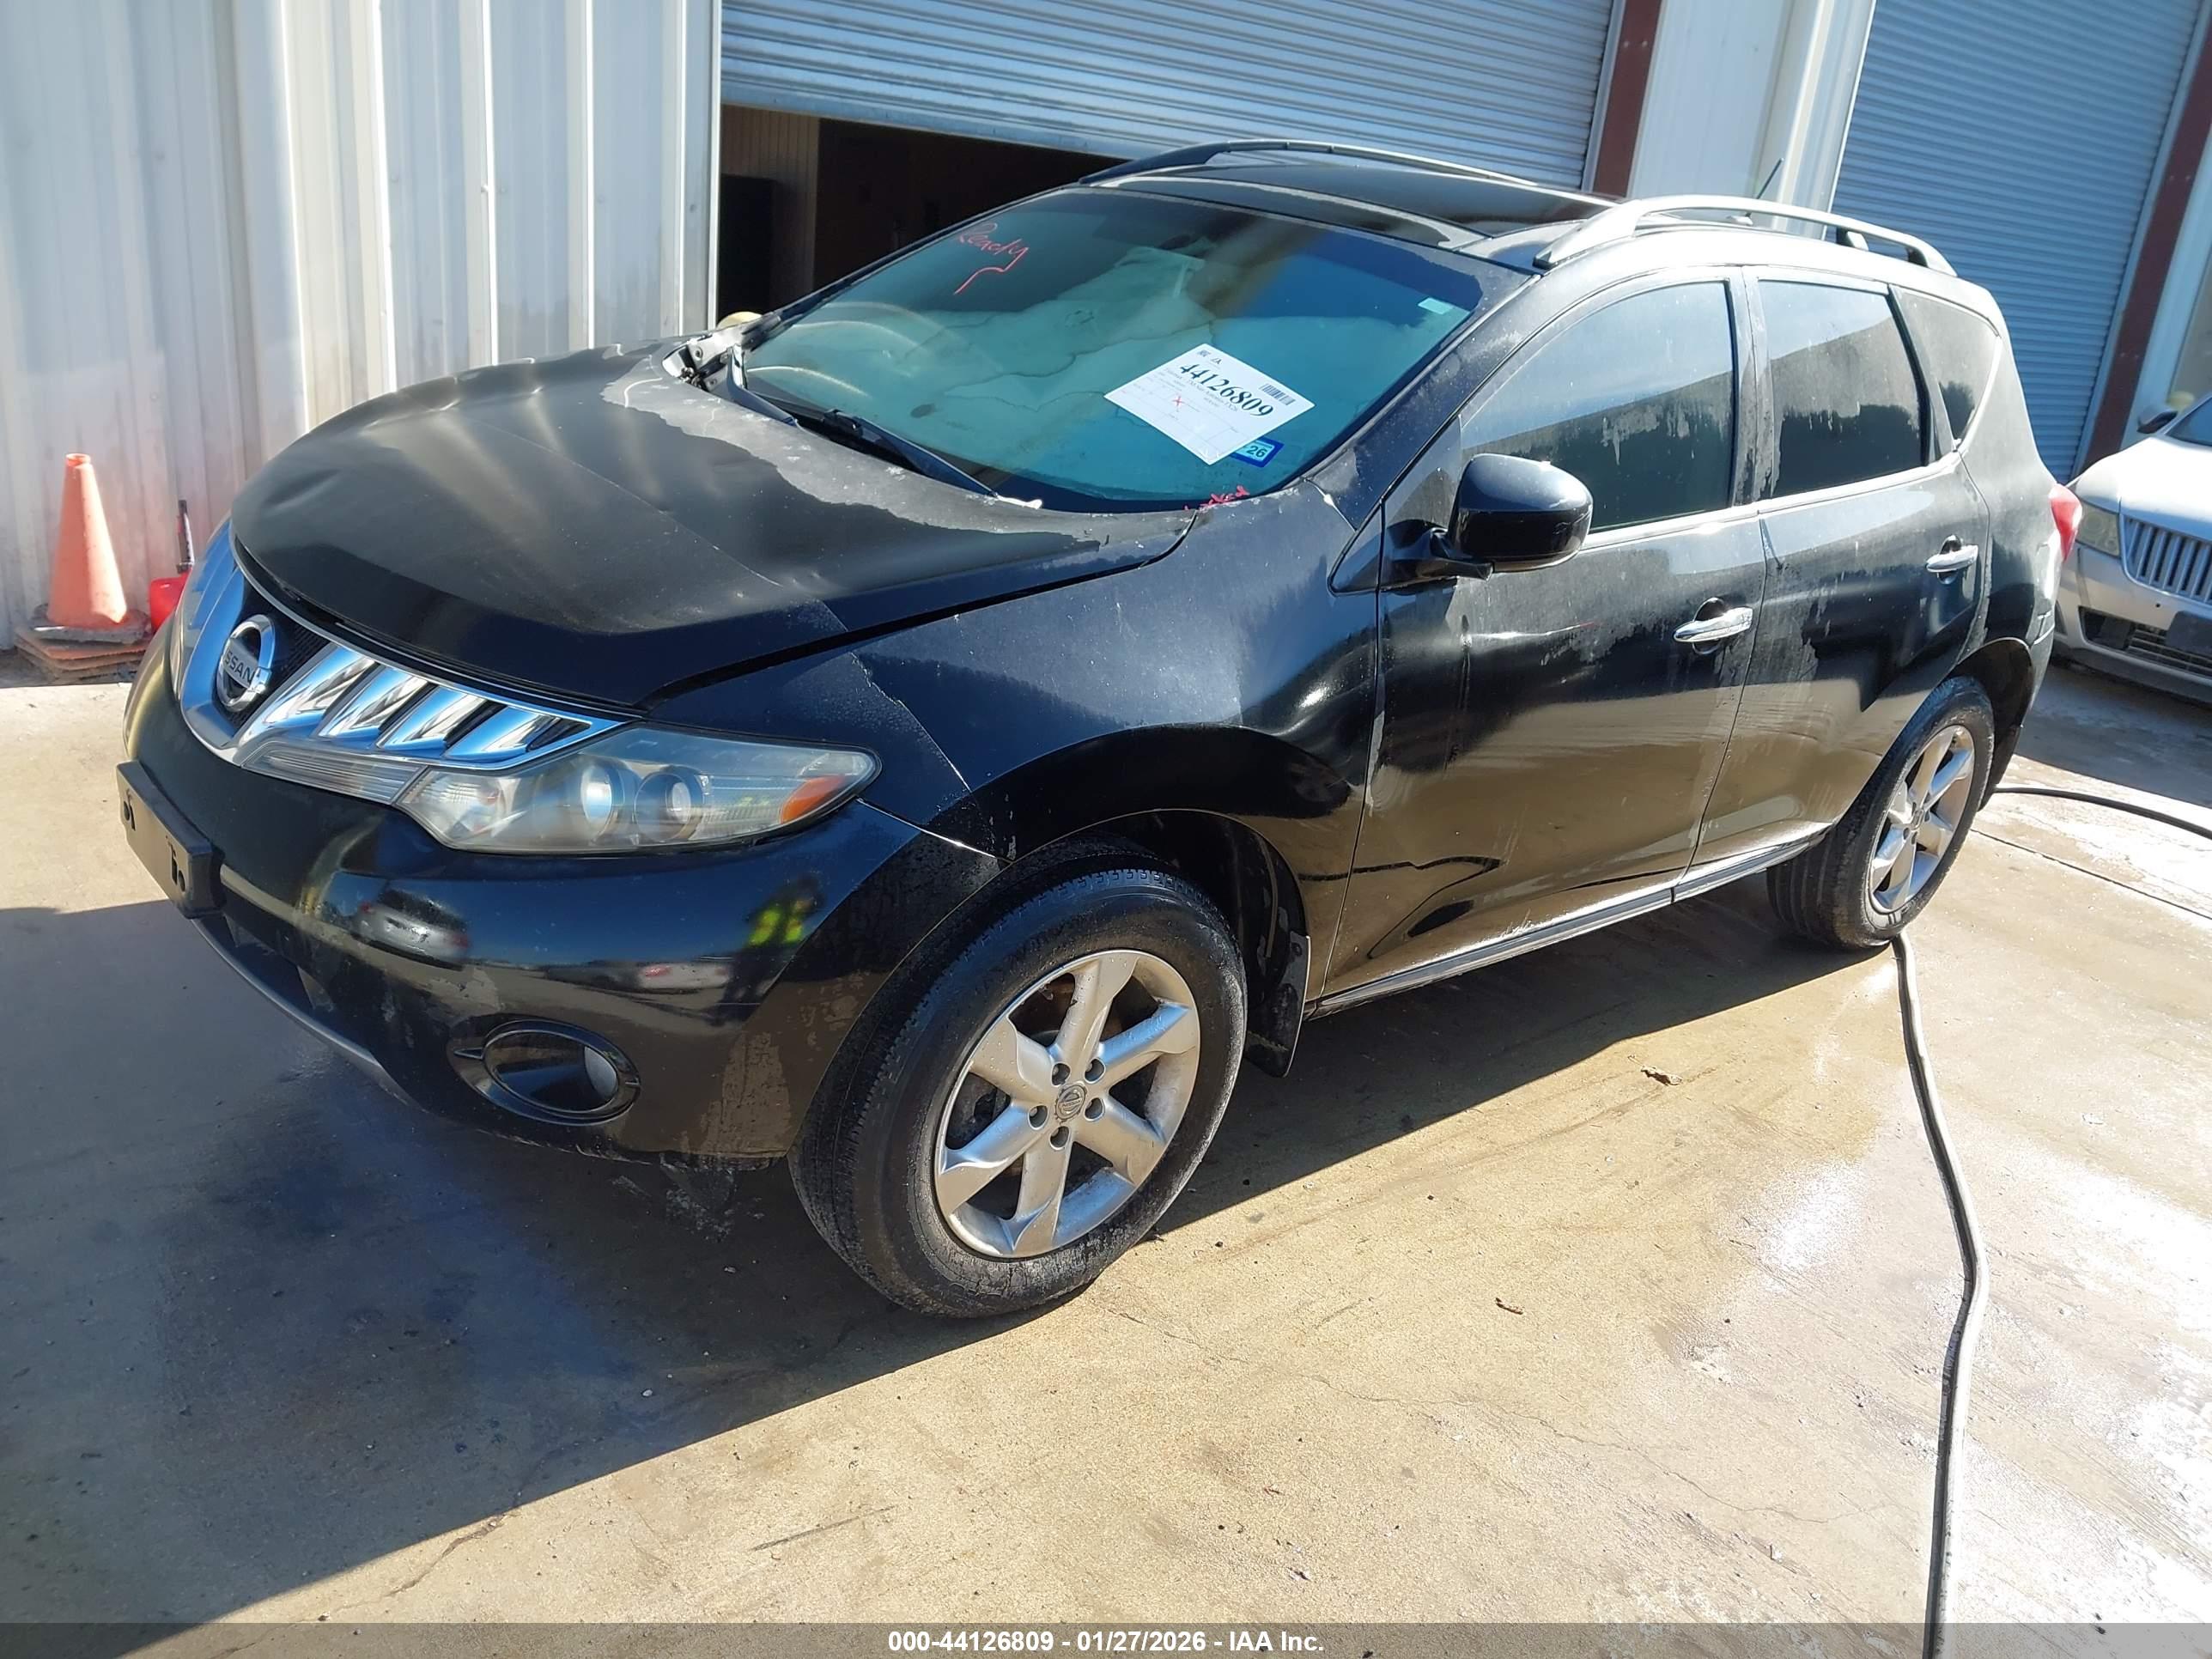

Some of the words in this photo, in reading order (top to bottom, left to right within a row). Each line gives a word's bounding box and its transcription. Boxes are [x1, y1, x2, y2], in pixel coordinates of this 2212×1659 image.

[954, 222, 1030, 294] Ready
[1181, 364, 1274, 417] 44126809
[1246, 445, 1269, 458] 26
[224, 649, 256, 684] SSAN
